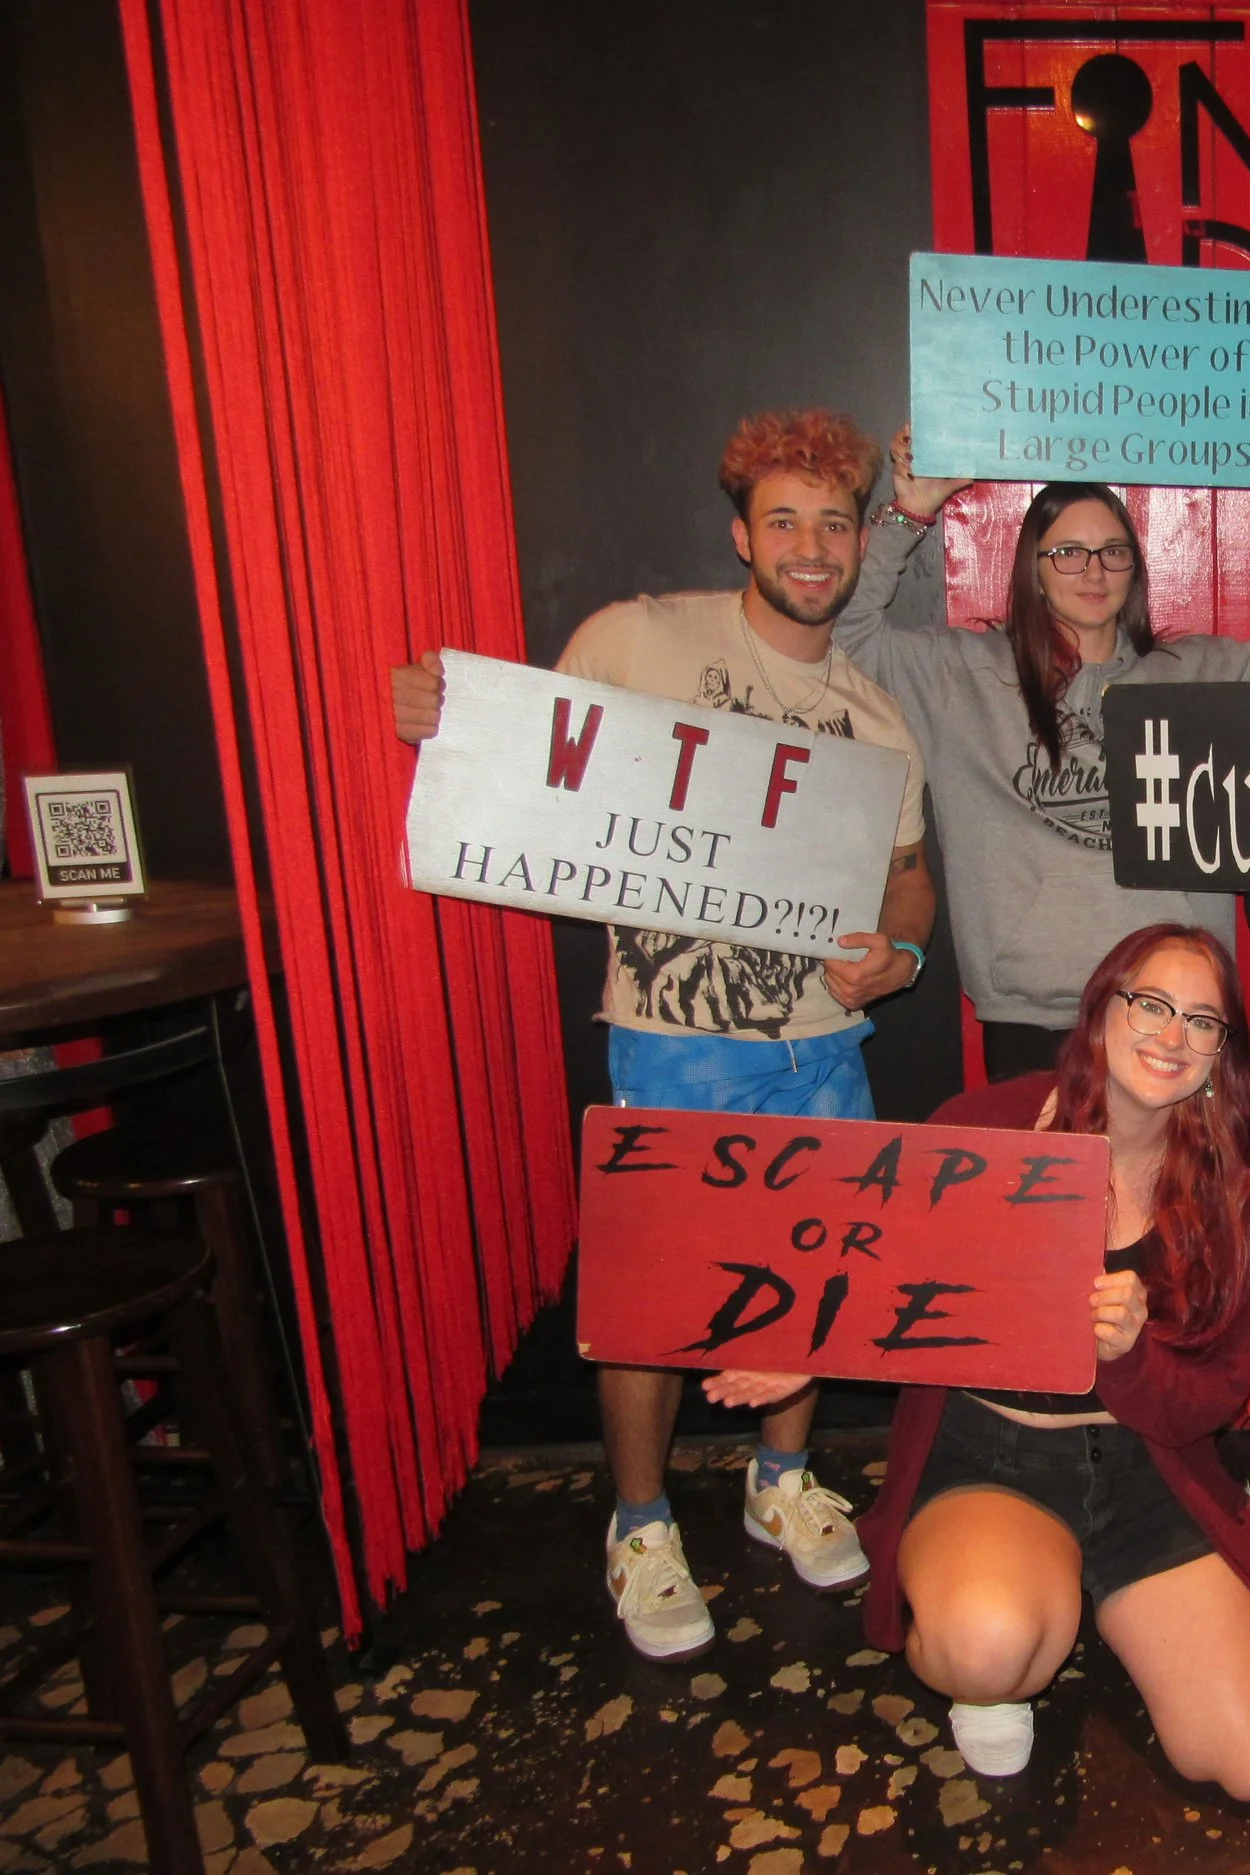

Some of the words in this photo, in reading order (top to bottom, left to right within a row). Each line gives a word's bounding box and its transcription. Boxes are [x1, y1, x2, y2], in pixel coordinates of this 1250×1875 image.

[919, 278, 1036, 316] Never
[1002, 330, 1066, 366] the
[1075, 334, 1201, 372] Power
[981, 379, 1104, 423] Stupid
[1113, 384, 1231, 427] People
[999, 428, 1111, 472] Large
[595, 812, 731, 869] JUST
[60, 870, 97, 882] SCAN
[100, 867, 121, 879] ME
[452, 841, 840, 944] HAPPENED?!?!
[596, 1124, 1089, 1212] ESCAPE
[790, 1218, 883, 1260] OR
[658, 1260, 1000, 1358] DIE
